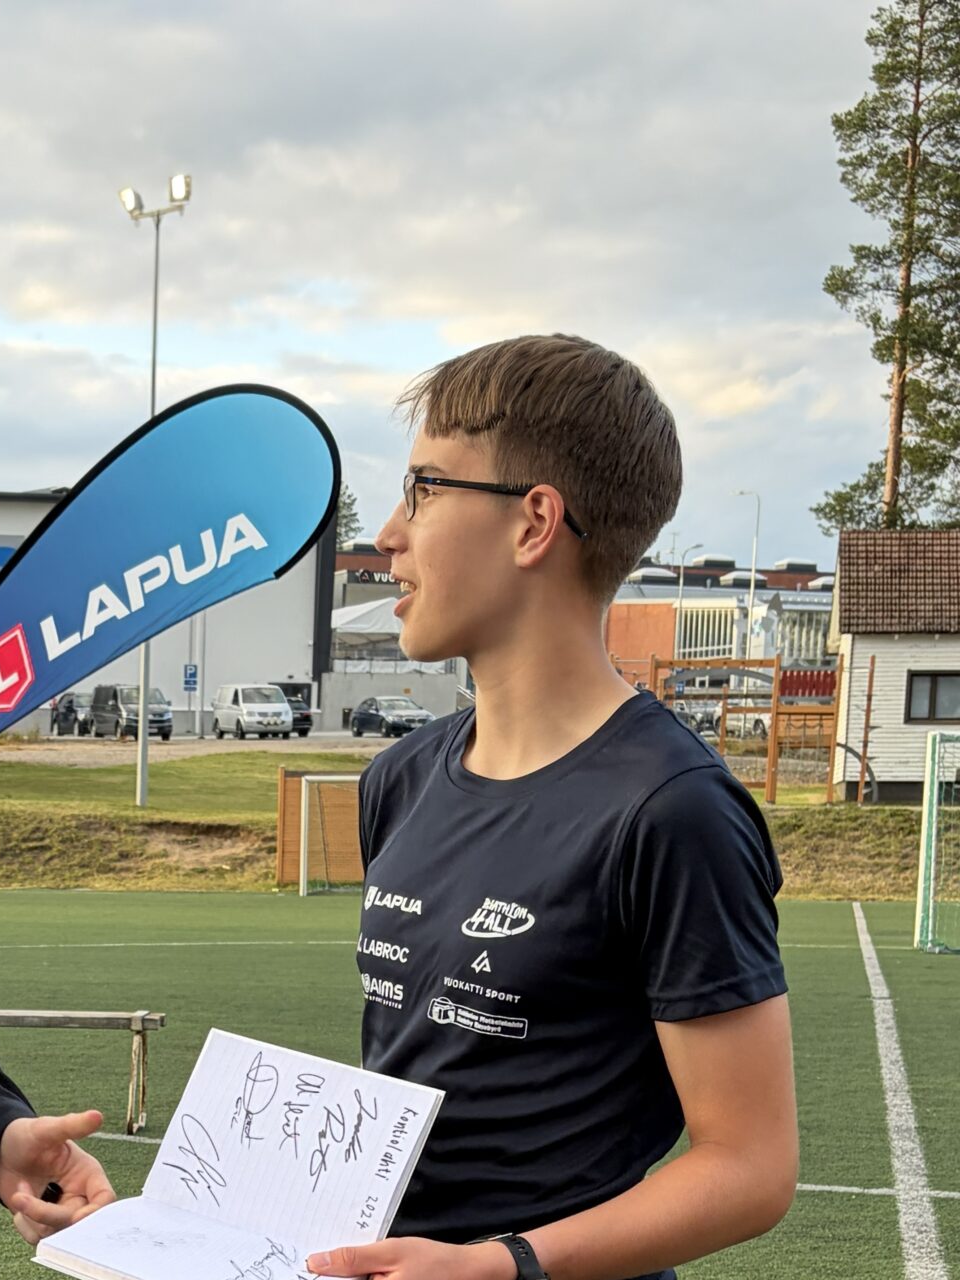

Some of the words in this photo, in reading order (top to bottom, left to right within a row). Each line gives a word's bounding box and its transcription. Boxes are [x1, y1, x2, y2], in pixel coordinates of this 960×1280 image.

[40, 513, 268, 661] LAPUA
[374, 891, 422, 915] LAPUA
[363, 938, 409, 963] LABROC
[443, 976, 483, 995] VUOKATTI
[485, 988, 521, 1004] SPORT
[356, 1196, 378, 1229] 2024
